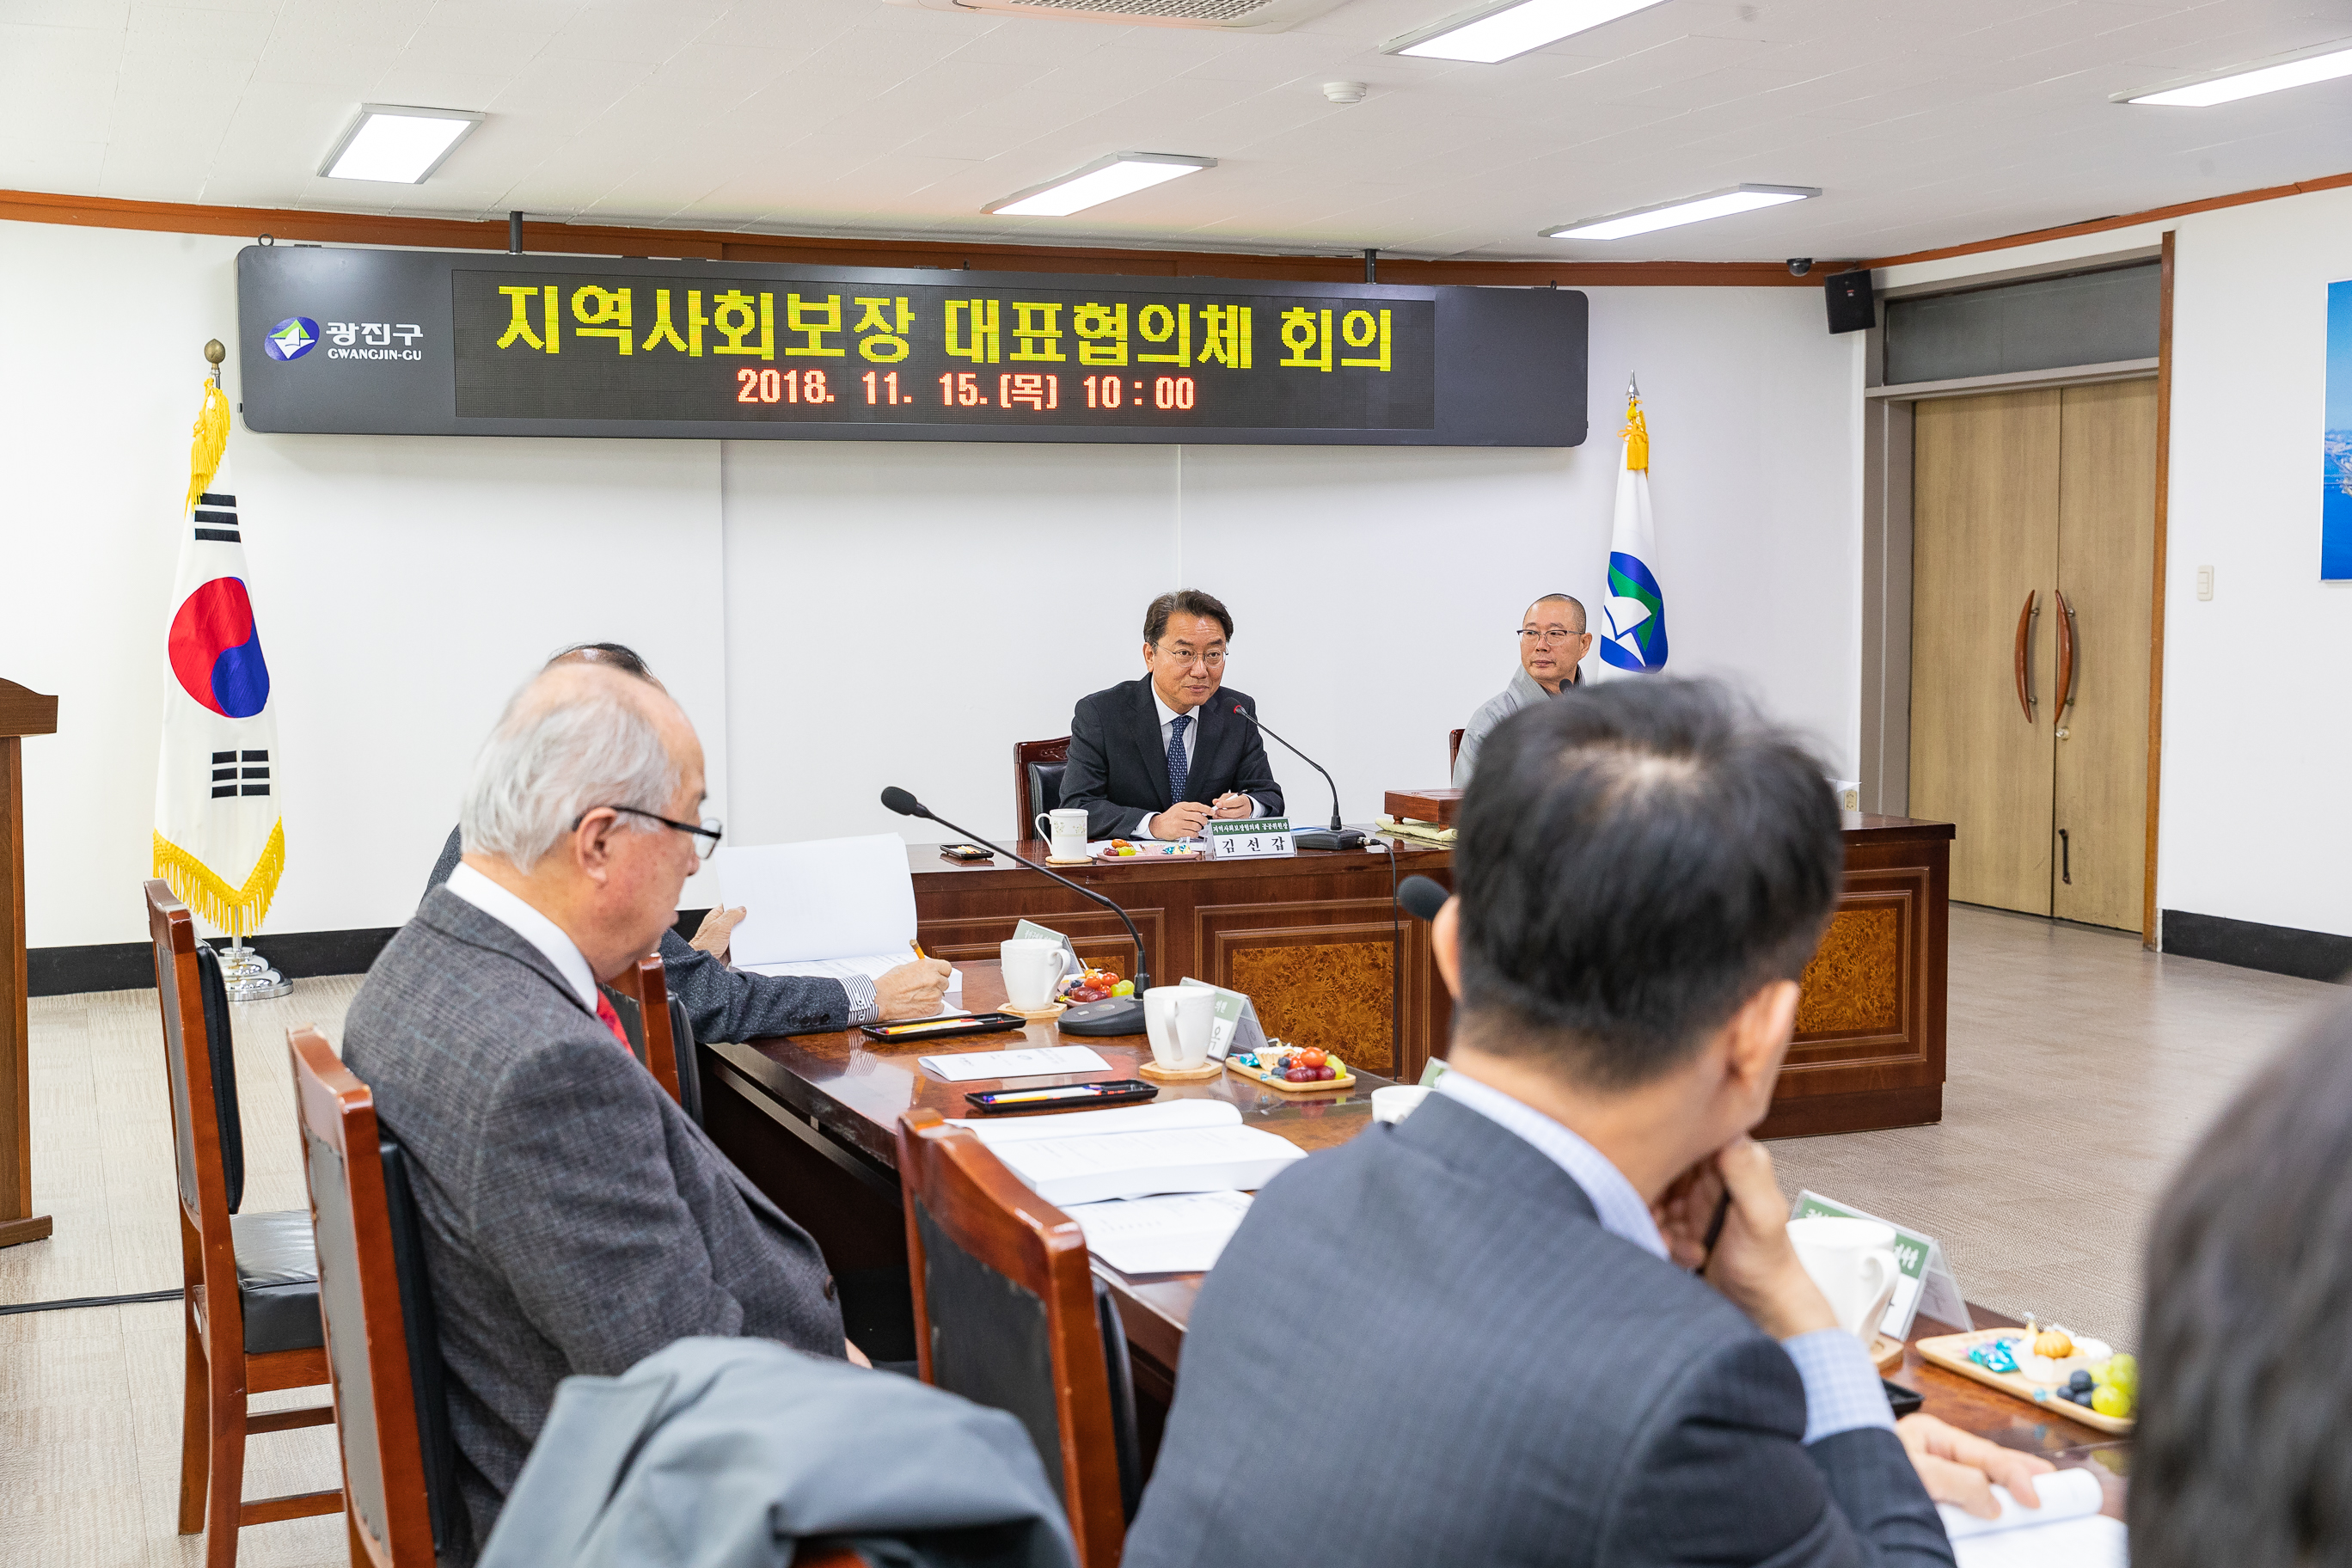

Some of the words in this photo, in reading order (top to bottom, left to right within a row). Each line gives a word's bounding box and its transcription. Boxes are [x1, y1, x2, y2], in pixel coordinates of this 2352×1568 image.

[326, 322, 424, 346] 광진구
[497, 285, 915, 364] 지역사회보장
[943, 298, 1253, 369] 대표협의체
[1280, 307, 1392, 372] 회의
[328, 348, 422, 361] GWANGJIN-GU
[738, 369, 835, 404] 2018.
[861, 371, 912, 406] 11.
